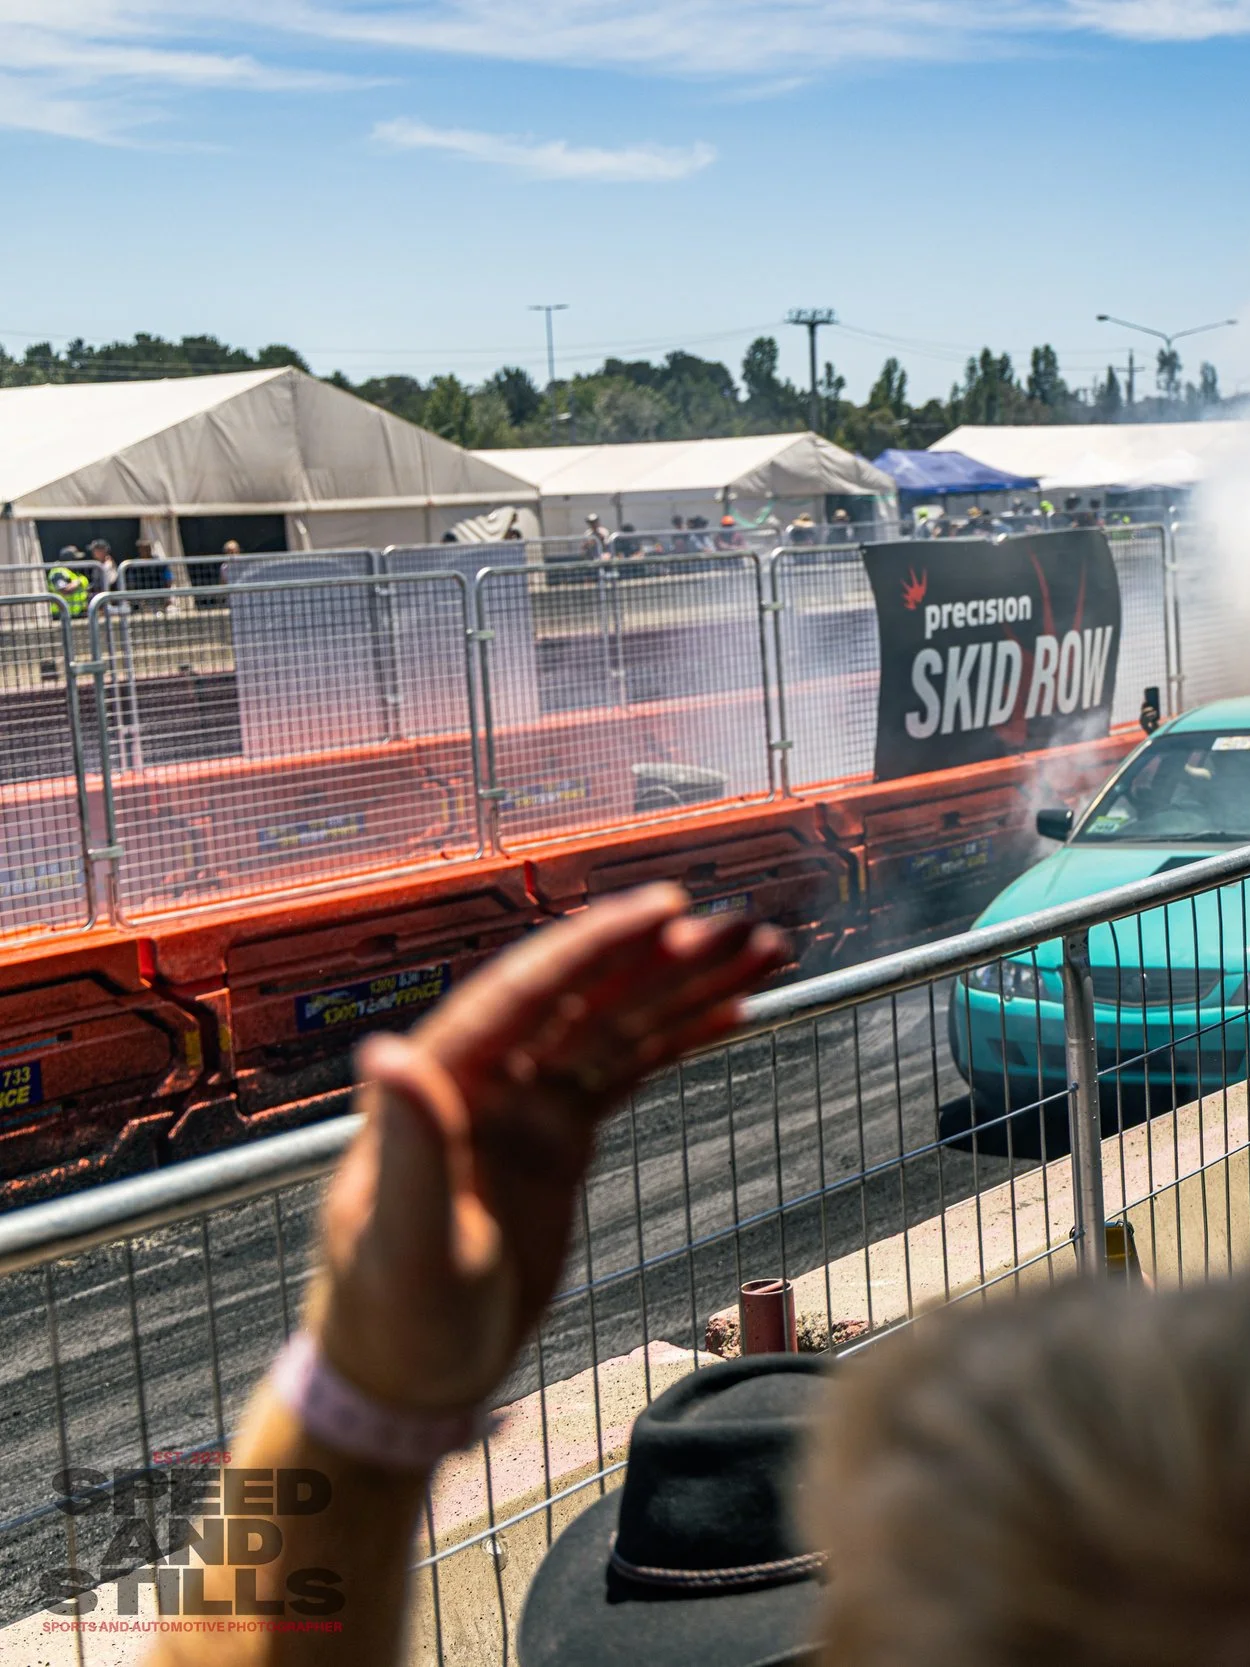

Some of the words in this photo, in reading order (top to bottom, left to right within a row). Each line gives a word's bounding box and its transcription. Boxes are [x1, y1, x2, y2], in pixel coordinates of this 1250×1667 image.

[925, 595, 1033, 640] precision
[905, 639, 1022, 740] SKID
[1024, 624, 1113, 720] ROW
